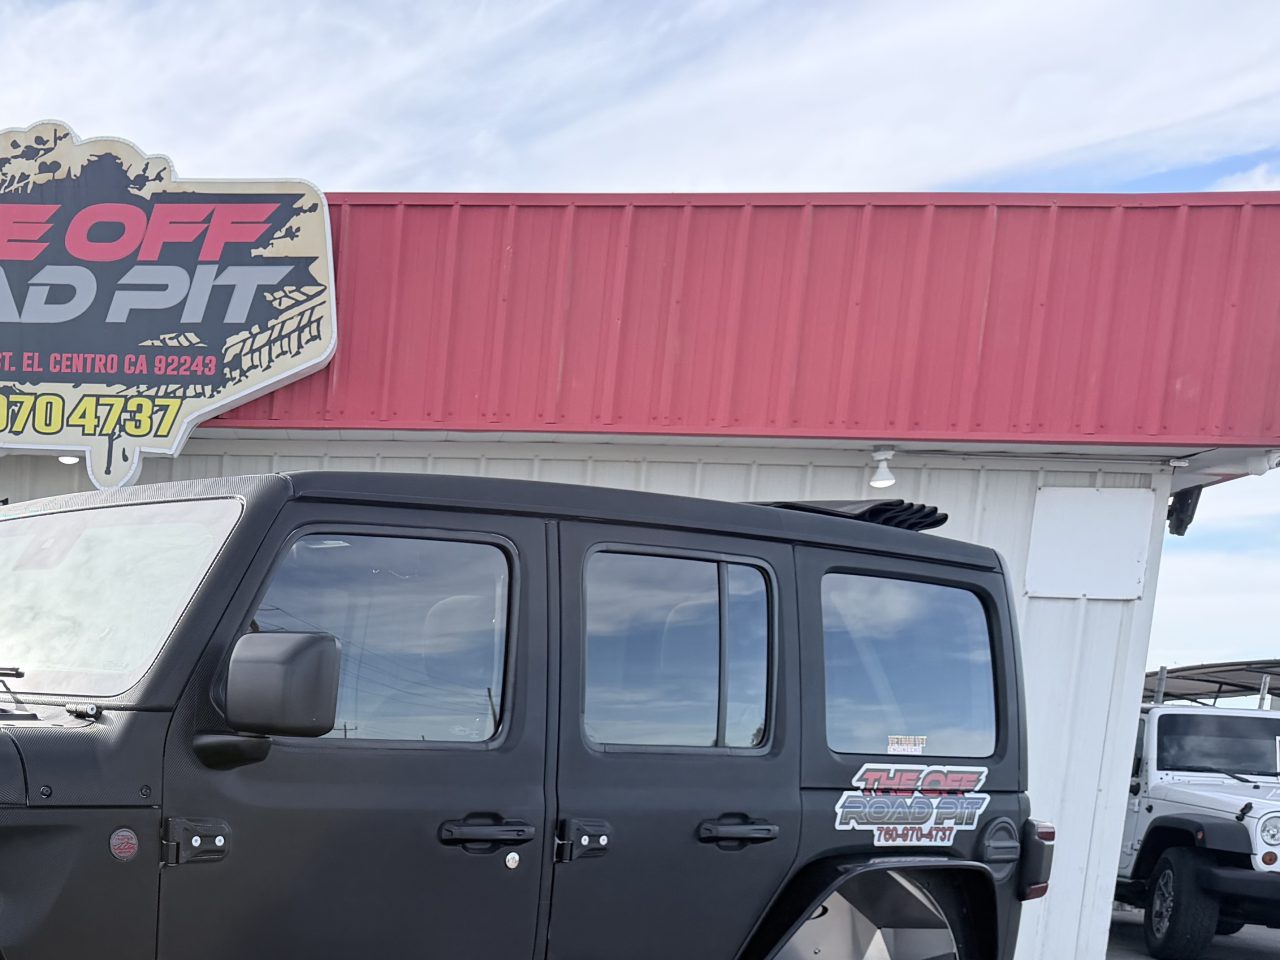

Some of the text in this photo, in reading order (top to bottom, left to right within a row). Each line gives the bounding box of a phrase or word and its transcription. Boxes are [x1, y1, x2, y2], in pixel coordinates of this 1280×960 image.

[64, 202, 281, 262] OFF
[105, 264, 295, 324] PIT
[22, 352, 43, 372] EL
[49, 352, 119, 374] CENTRO
[124, 354, 148, 375] CA
[154, 355, 217, 376] 92243
[66, 393, 185, 438] 4737
[859, 769, 983, 798] THE OFF
[839, 795, 987, 826] ROAD PIT
